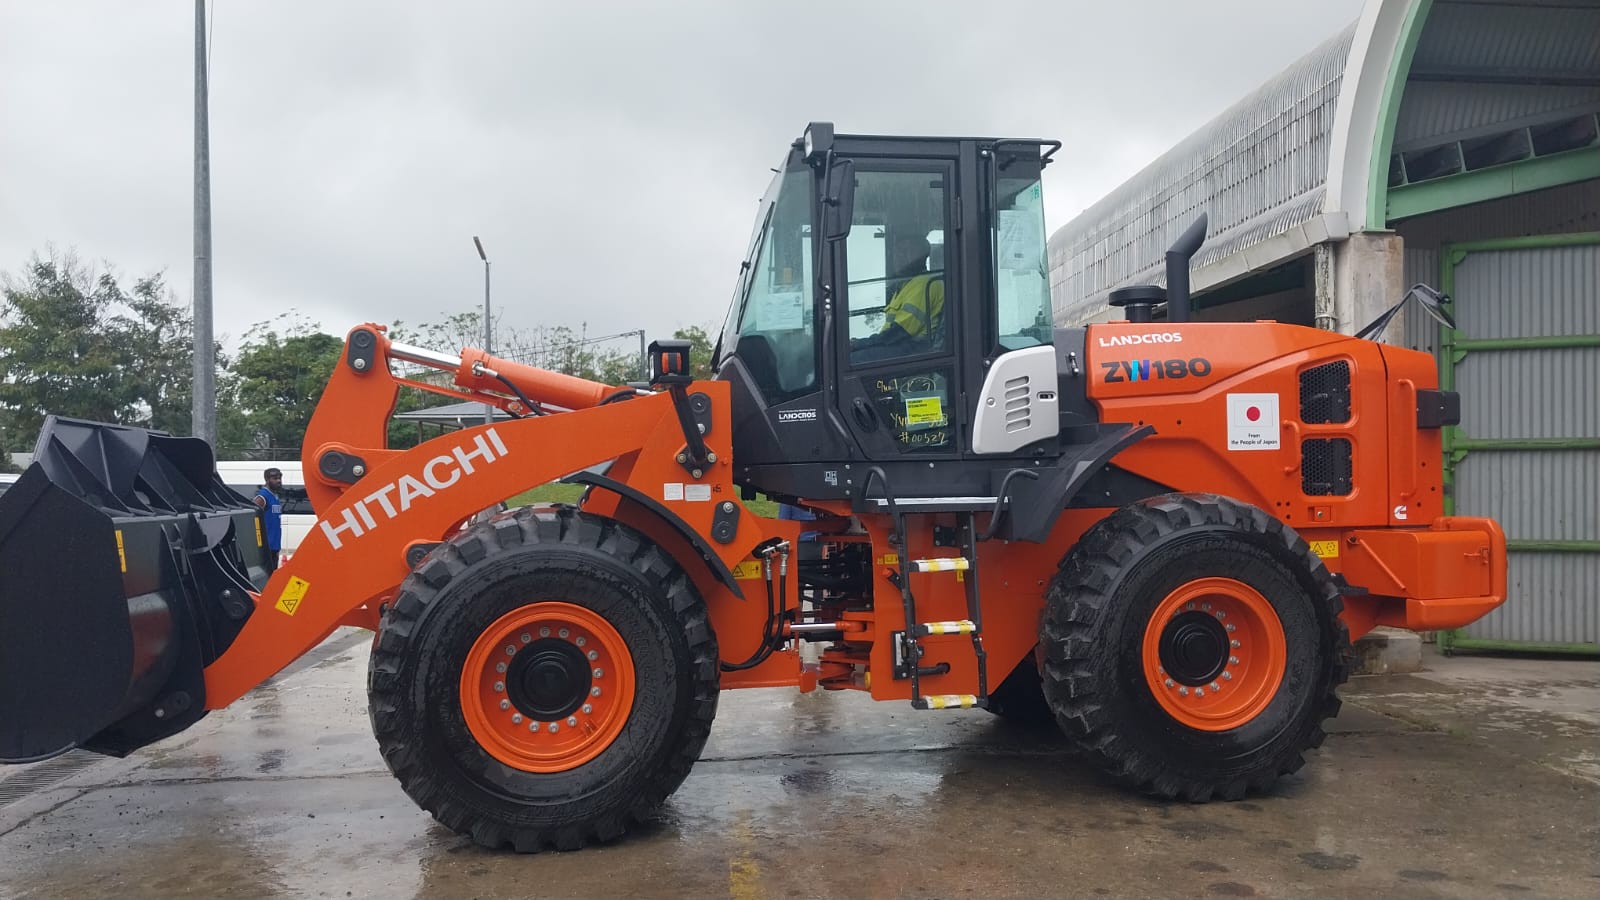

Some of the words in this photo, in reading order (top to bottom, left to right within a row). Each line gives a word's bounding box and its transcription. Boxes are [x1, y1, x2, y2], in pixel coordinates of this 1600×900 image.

[1098, 332, 1183, 347] LANDCROS
[1101, 357, 1212, 384] ZW180
[778, 412, 817, 420] LANDCROS
[319, 427, 509, 550] HITACHI
